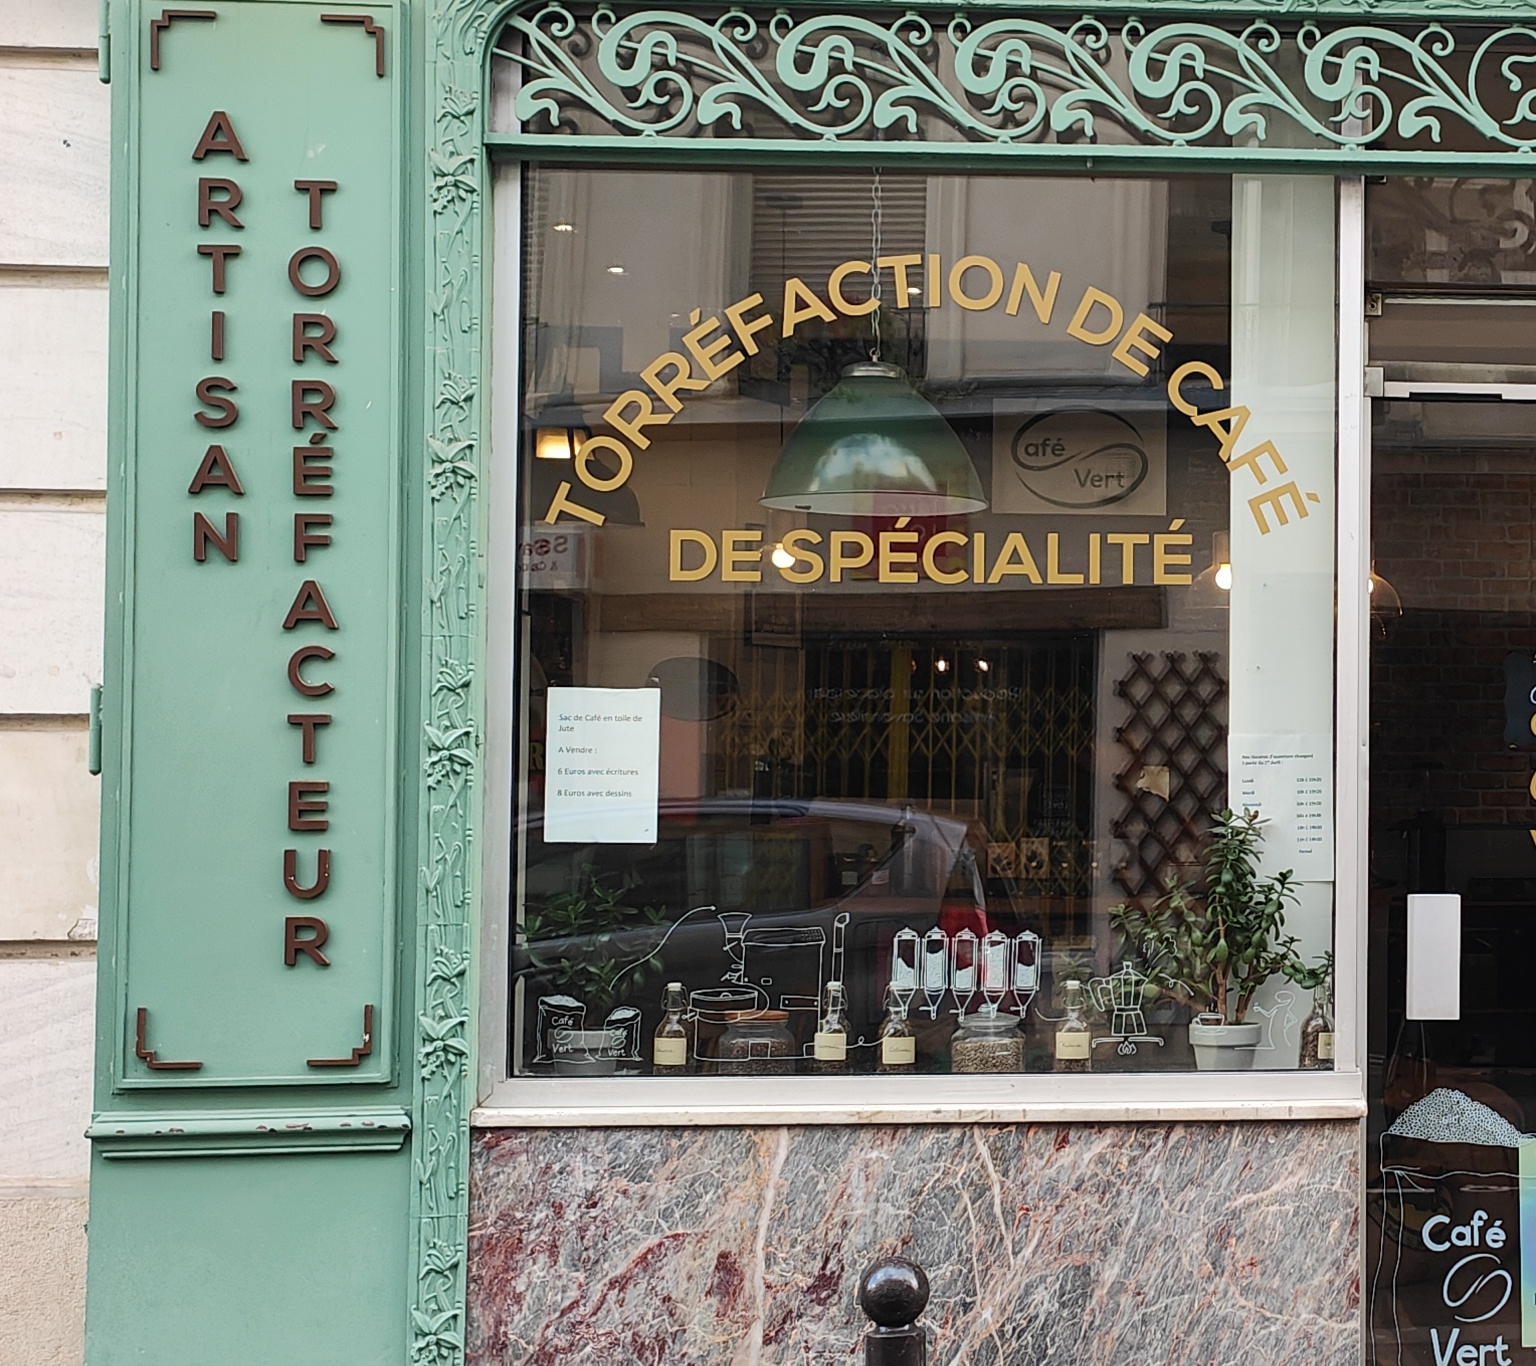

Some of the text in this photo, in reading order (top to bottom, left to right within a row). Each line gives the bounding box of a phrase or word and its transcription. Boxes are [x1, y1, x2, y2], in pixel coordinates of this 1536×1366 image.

[188, 109, 250, 566] ARTISAN
[545, 253, 1321, 537] TORRÉFACTION DE CAFÉ
[1073, 467, 1126, 490] Vert
[668, 515, 1194, 587] DE SPÉCIALITÉ
[281, 178, 342, 970] TORRÉFACTEUR
[558, 713, 572, 722] Sac
[573, 714, 583, 722] de
[584, 714, 601, 722] Café
[614, 714, 631, 722] toile
[632, 714, 643, 722] de
[558, 724, 575, 733] Jute
[557, 746, 564, 754] A
[565, 746, 593, 754] Vendre
[557, 768, 563, 776] 6
[564, 768, 586, 776] Euros
[606, 768, 639, 776] écritures
[564, 789, 585, 797] Euros
[605, 789, 632, 797] dessins
[551, 1015, 575, 1027] Café
[552, 1043, 574, 1054] Vert
[607, 1047, 627, 1057] Vert
[1421, 1209, 1507, 1253] Café
